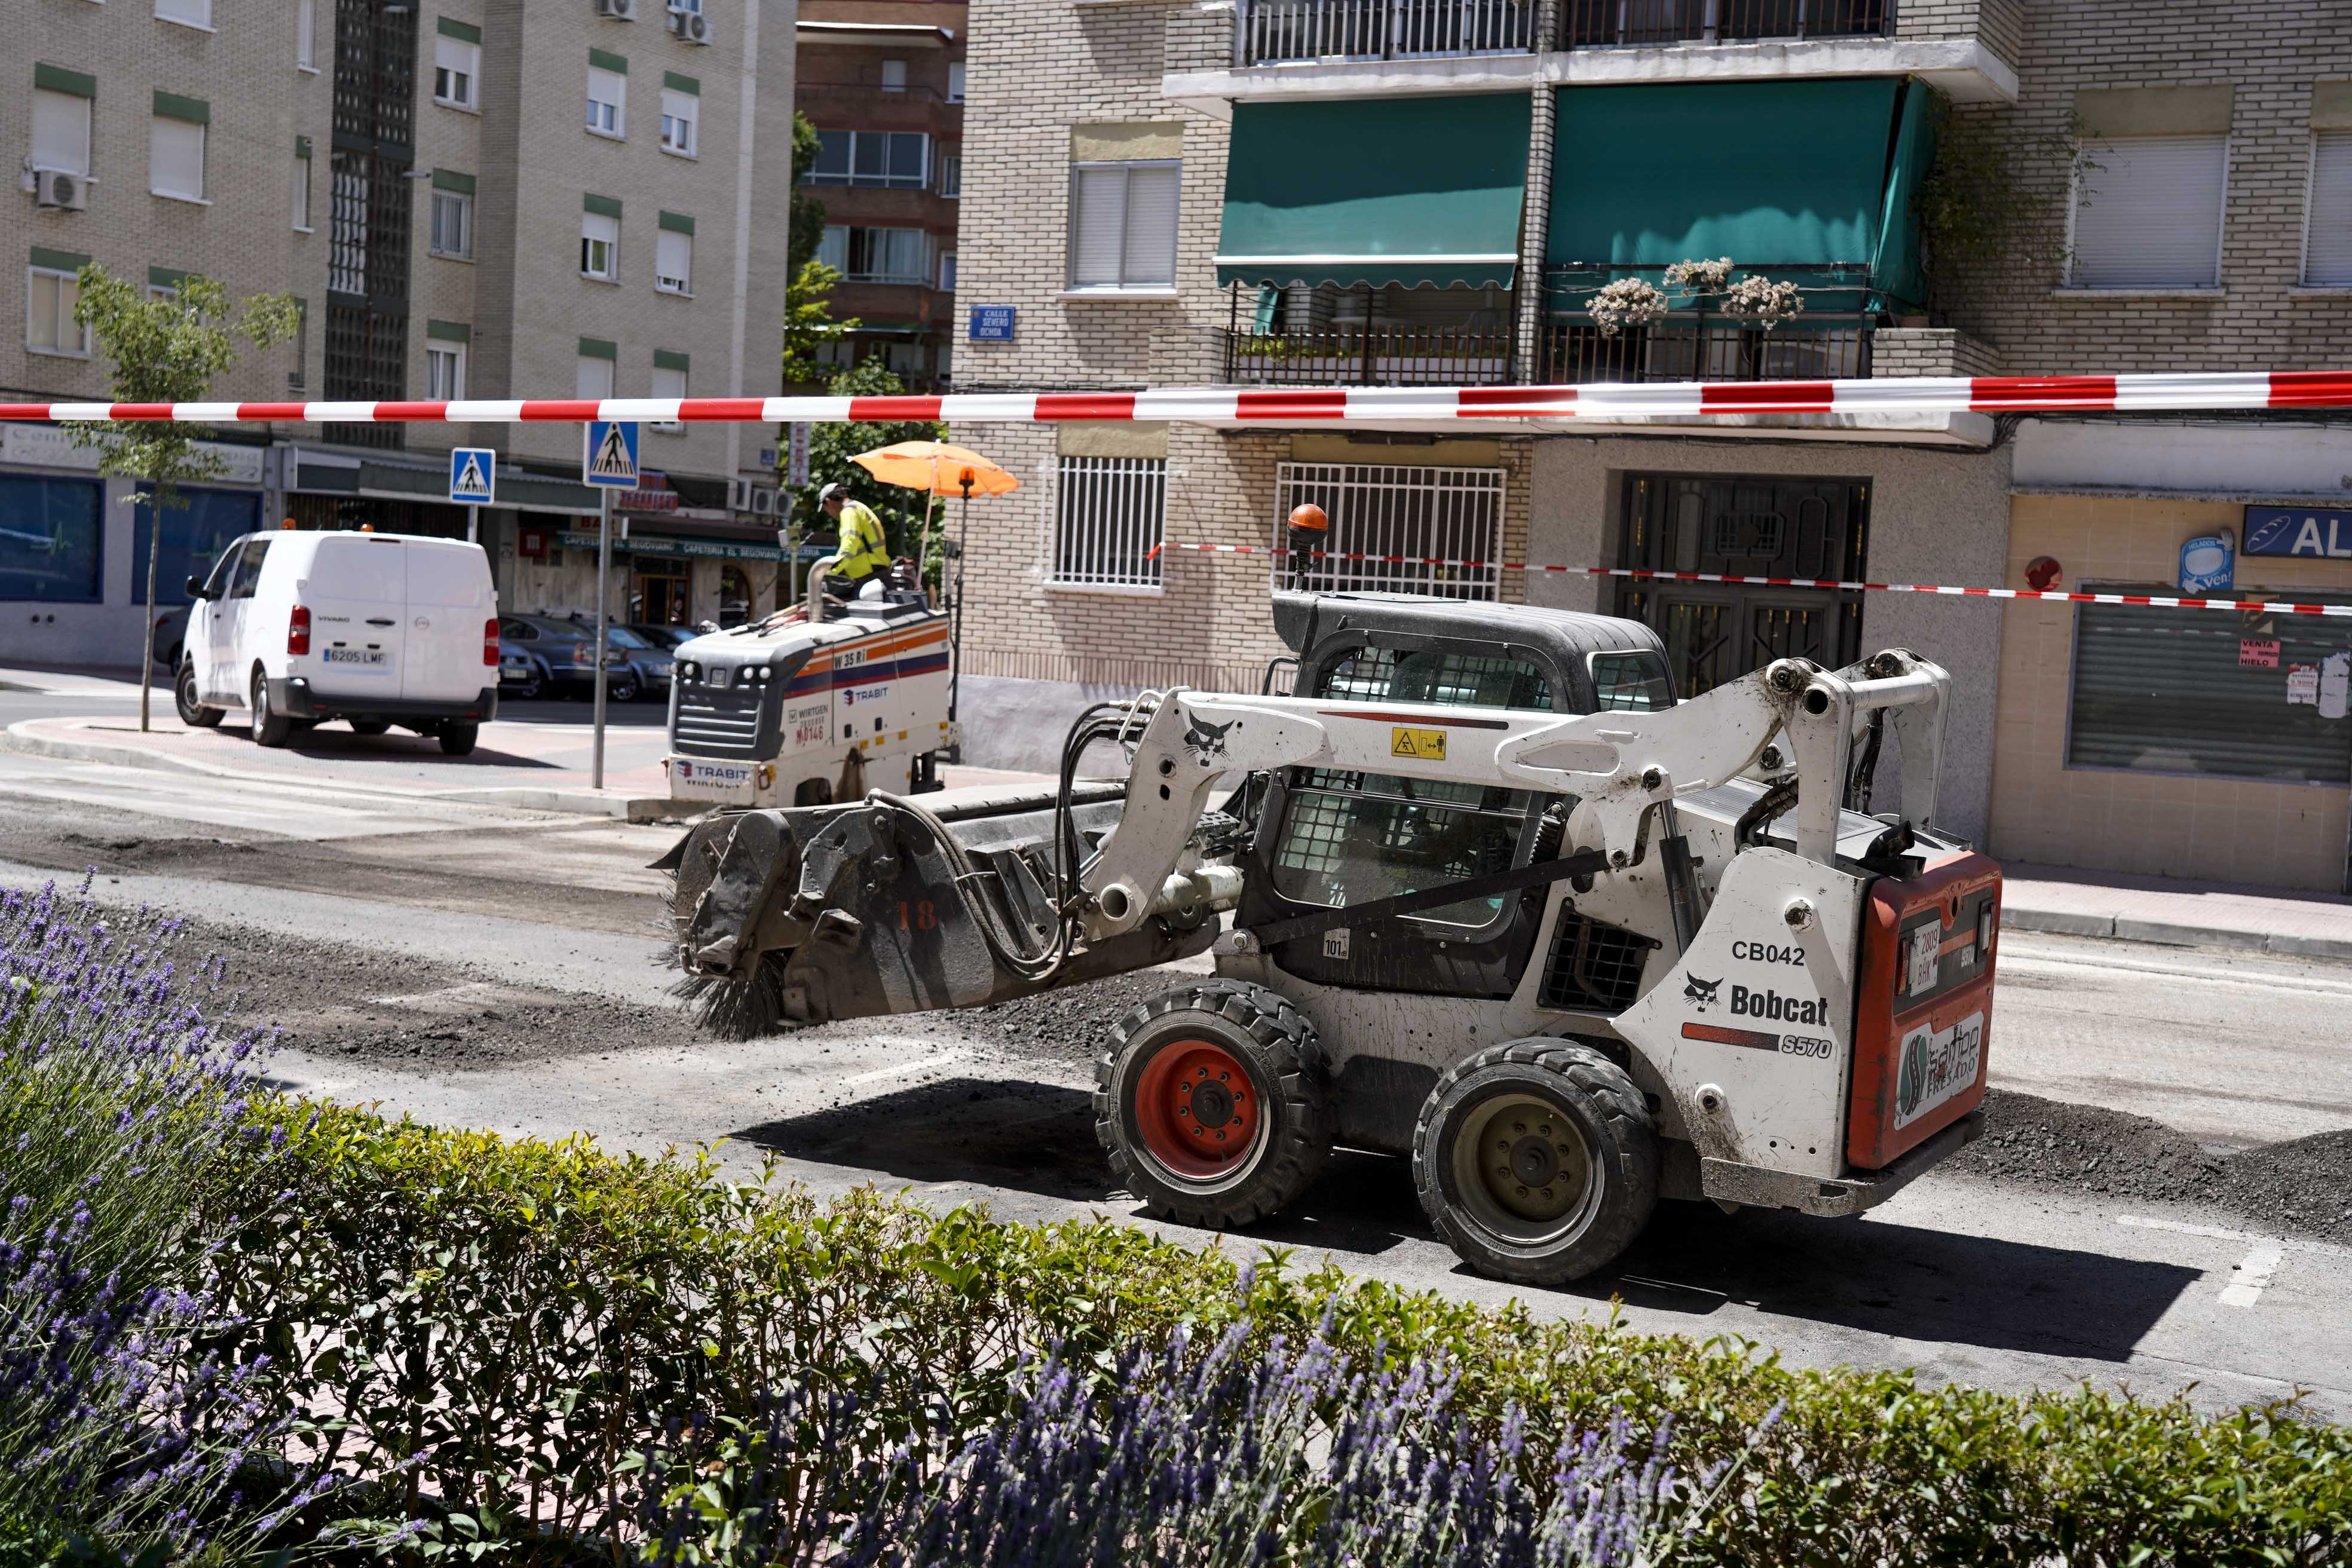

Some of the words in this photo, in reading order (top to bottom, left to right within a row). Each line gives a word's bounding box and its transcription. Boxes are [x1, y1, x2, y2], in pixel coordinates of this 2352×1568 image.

[982, 318, 1009, 326] SEVERO
[980, 327, 1002, 336] OCHOA
[683, 542, 724, 556] CAFETERIA
[726, 548, 737, 558] EL
[740, 549, 782, 559] SEGOVIANO
[2188, 540, 2216, 550] HELADOS
[331, 650, 360, 663] 6205
[835, 656, 843, 668] W
[844, 653, 854, 666] 35
[856, 687, 888, 701] TRABIT
[798, 704, 829, 719] WIRTGEN
[696, 765, 749, 780] TRABIT
[900, 901, 938, 930] 18
[1325, 939, 1342, 956] 101
[1921, 928, 1938, 955] 2809
[1732, 941, 1805, 966] CB042
[1731, 984, 1828, 1027] Bobcat
[1781, 1034, 1832, 1059] S570
